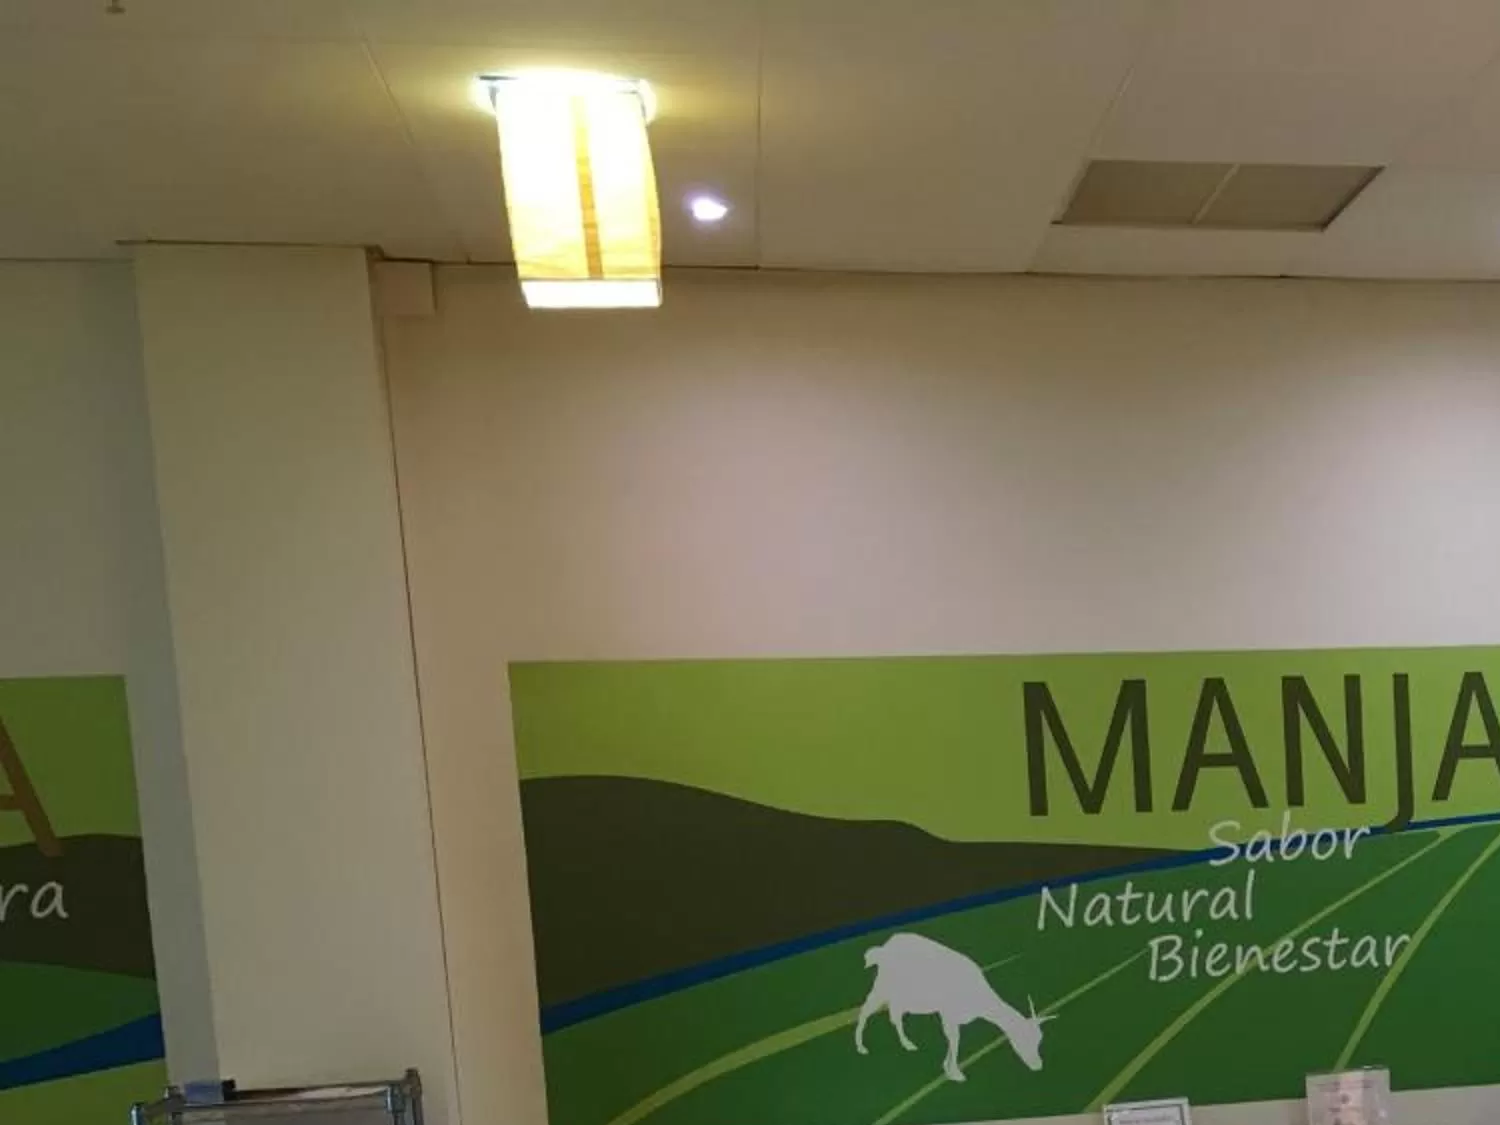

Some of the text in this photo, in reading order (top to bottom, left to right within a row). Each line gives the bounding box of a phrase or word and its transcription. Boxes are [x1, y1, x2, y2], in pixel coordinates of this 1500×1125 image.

[1207, 809, 1372, 868] Sabor
[1036, 869, 1256, 930] Natural
[1147, 927, 1413, 983] Bienestar
